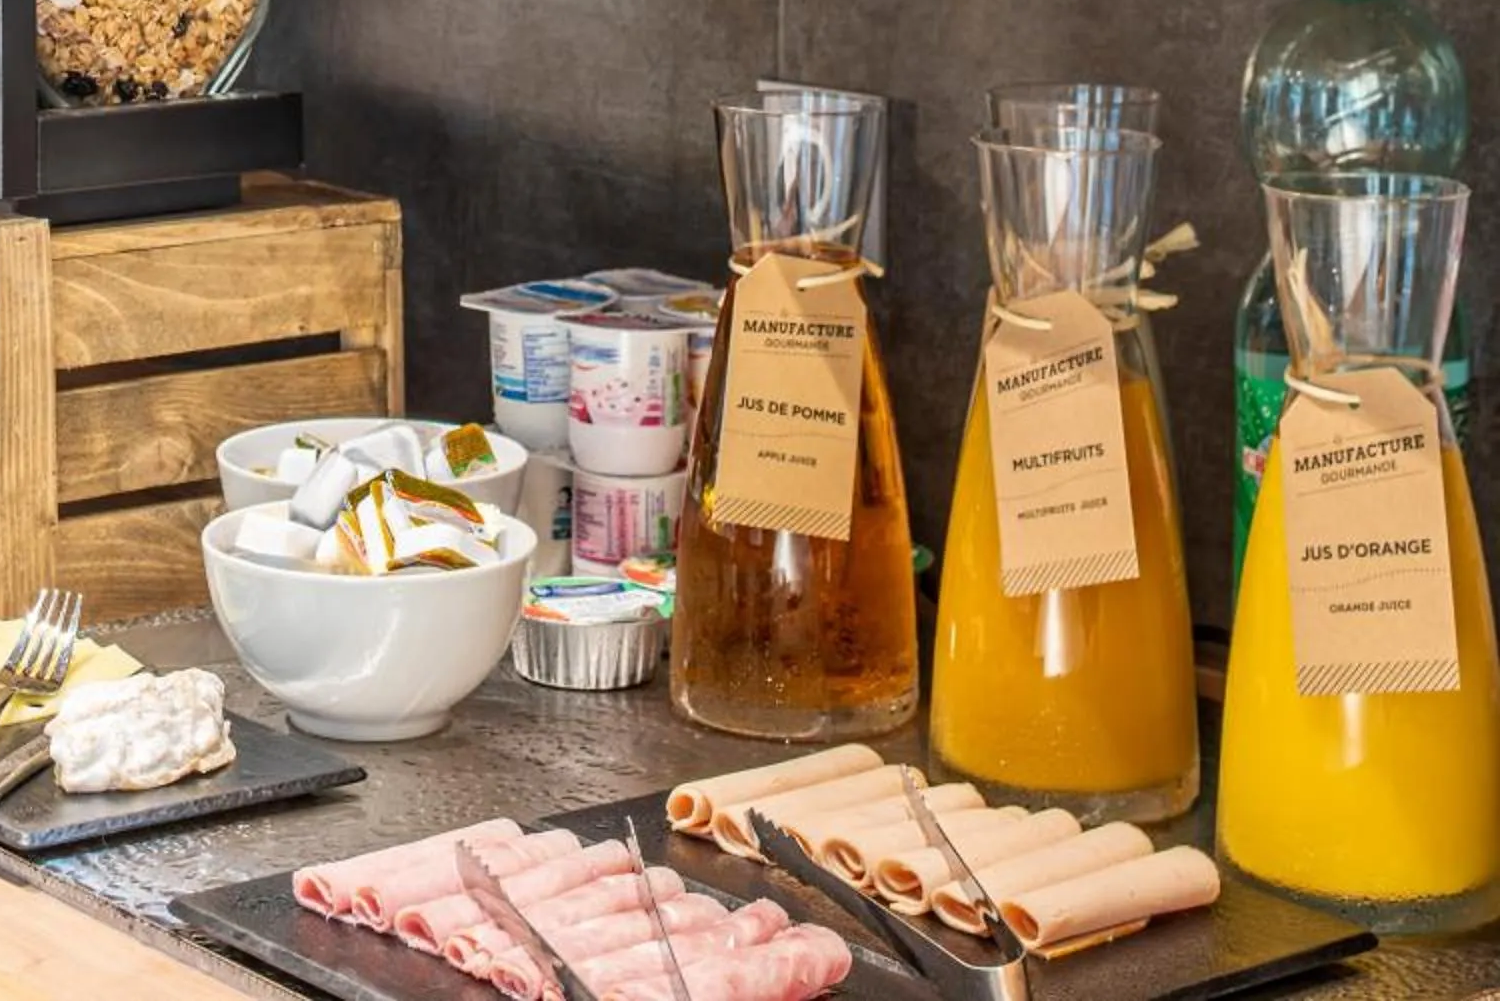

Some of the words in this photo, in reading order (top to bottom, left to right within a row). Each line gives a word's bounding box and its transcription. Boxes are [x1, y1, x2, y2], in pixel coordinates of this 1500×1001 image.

[743, 319, 854, 339] MANUFACTURE
[764, 339, 830, 352] GOURMANDE
[997, 346, 1104, 394] MANUFACTURE
[736, 396, 765, 412] JUS
[768, 401, 788, 416] DE
[792, 404, 846, 426] POMME
[758, 450, 786, 464] APPLE
[789, 456, 817, 468] JUICE
[1012, 443, 1105, 472] MULTIFRUITS
[1294, 433, 1425, 474] MANUFACTURE
[1320, 460, 1398, 485] GOURMANDE
[1301, 543, 1333, 562] JUS
[1338, 538, 1432, 560] D'ORANGE
[1329, 600, 1375, 614] ORANGE
[1378, 599, 1412, 612] JUICE
